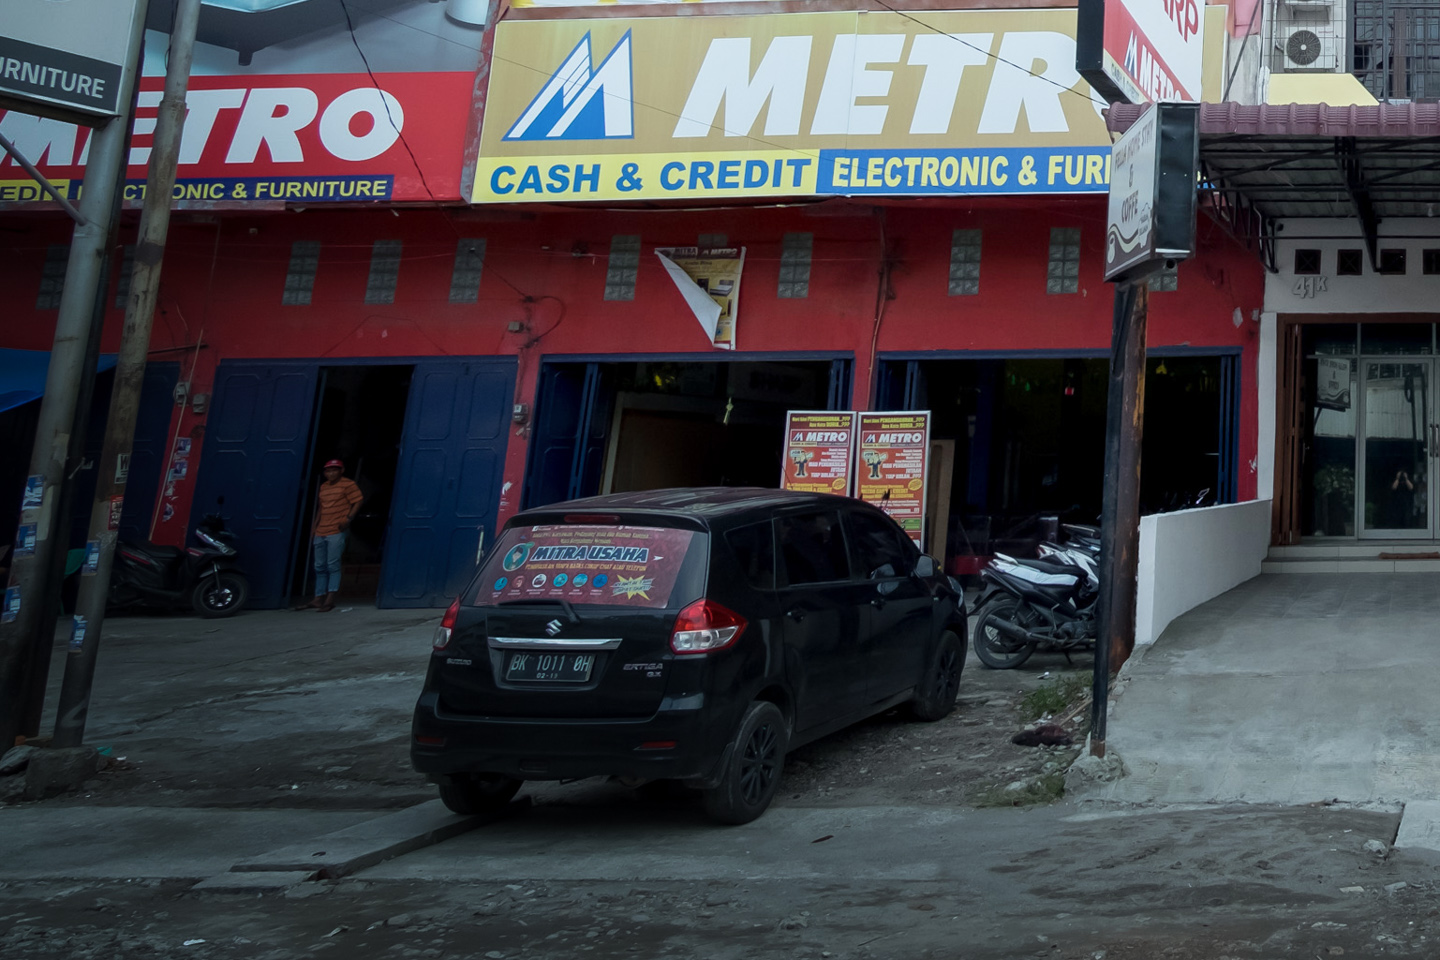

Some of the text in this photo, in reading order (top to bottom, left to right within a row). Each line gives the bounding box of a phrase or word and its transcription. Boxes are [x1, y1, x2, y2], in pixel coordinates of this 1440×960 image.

[673, 30, 1110, 138] METR
[489, 164, 602, 195] CASH
[615, 162, 644, 192] &
[659, 157, 812, 191] CREDIT
[830, 155, 1010, 188] ELECTRONIC
[1016, 154, 1040, 185] &
[232, 182, 248, 199] &
[256, 179, 387, 200] FURNITURE
[805, 432, 848, 443] METRO
[877, 432, 922, 444] METRO
[511, 654, 530, 672] BK
[536, 654, 566, 672] 1011
